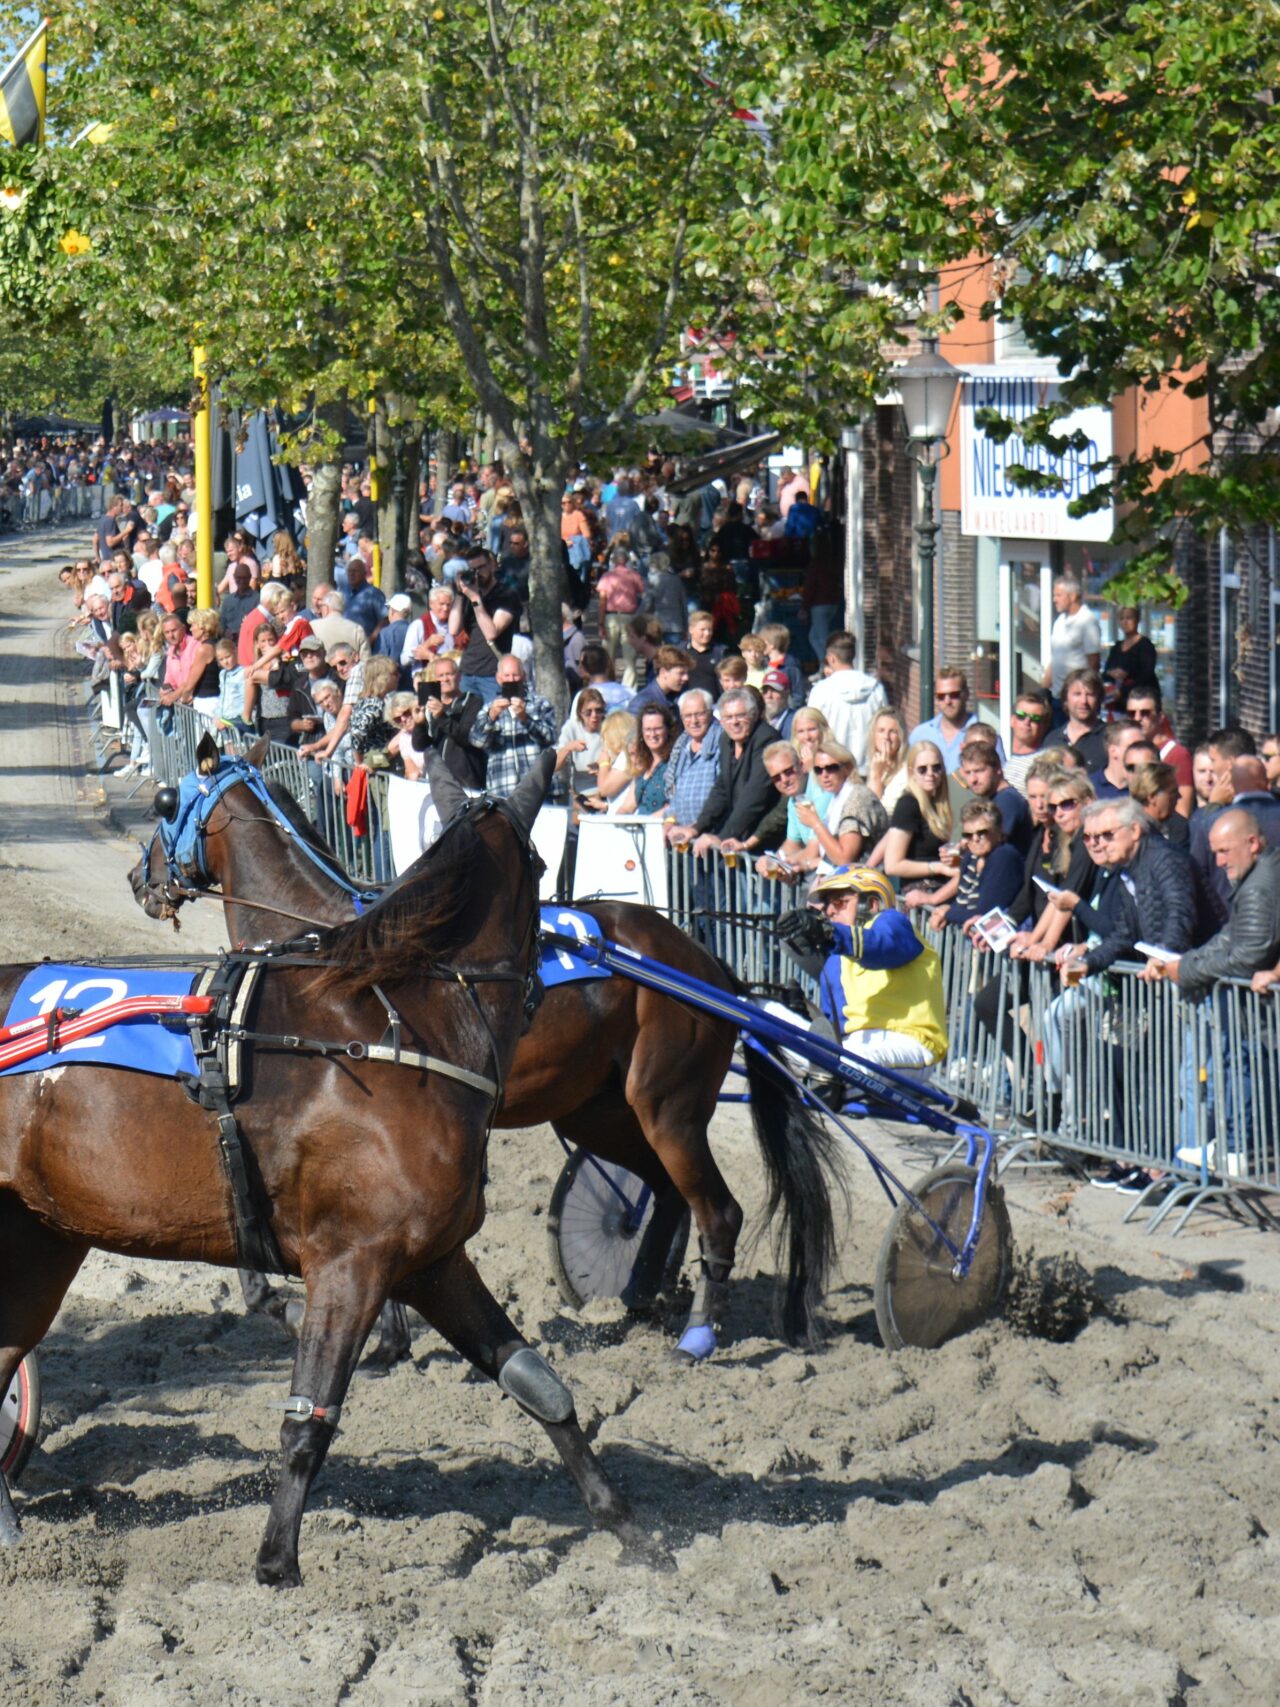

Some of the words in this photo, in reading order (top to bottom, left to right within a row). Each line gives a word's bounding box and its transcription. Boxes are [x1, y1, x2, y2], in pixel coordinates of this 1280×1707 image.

[974, 510, 1060, 535] MAKELAARDIJ
[28, 978, 129, 1056] 12
[837, 1063, 887, 1094] CUSTOM
